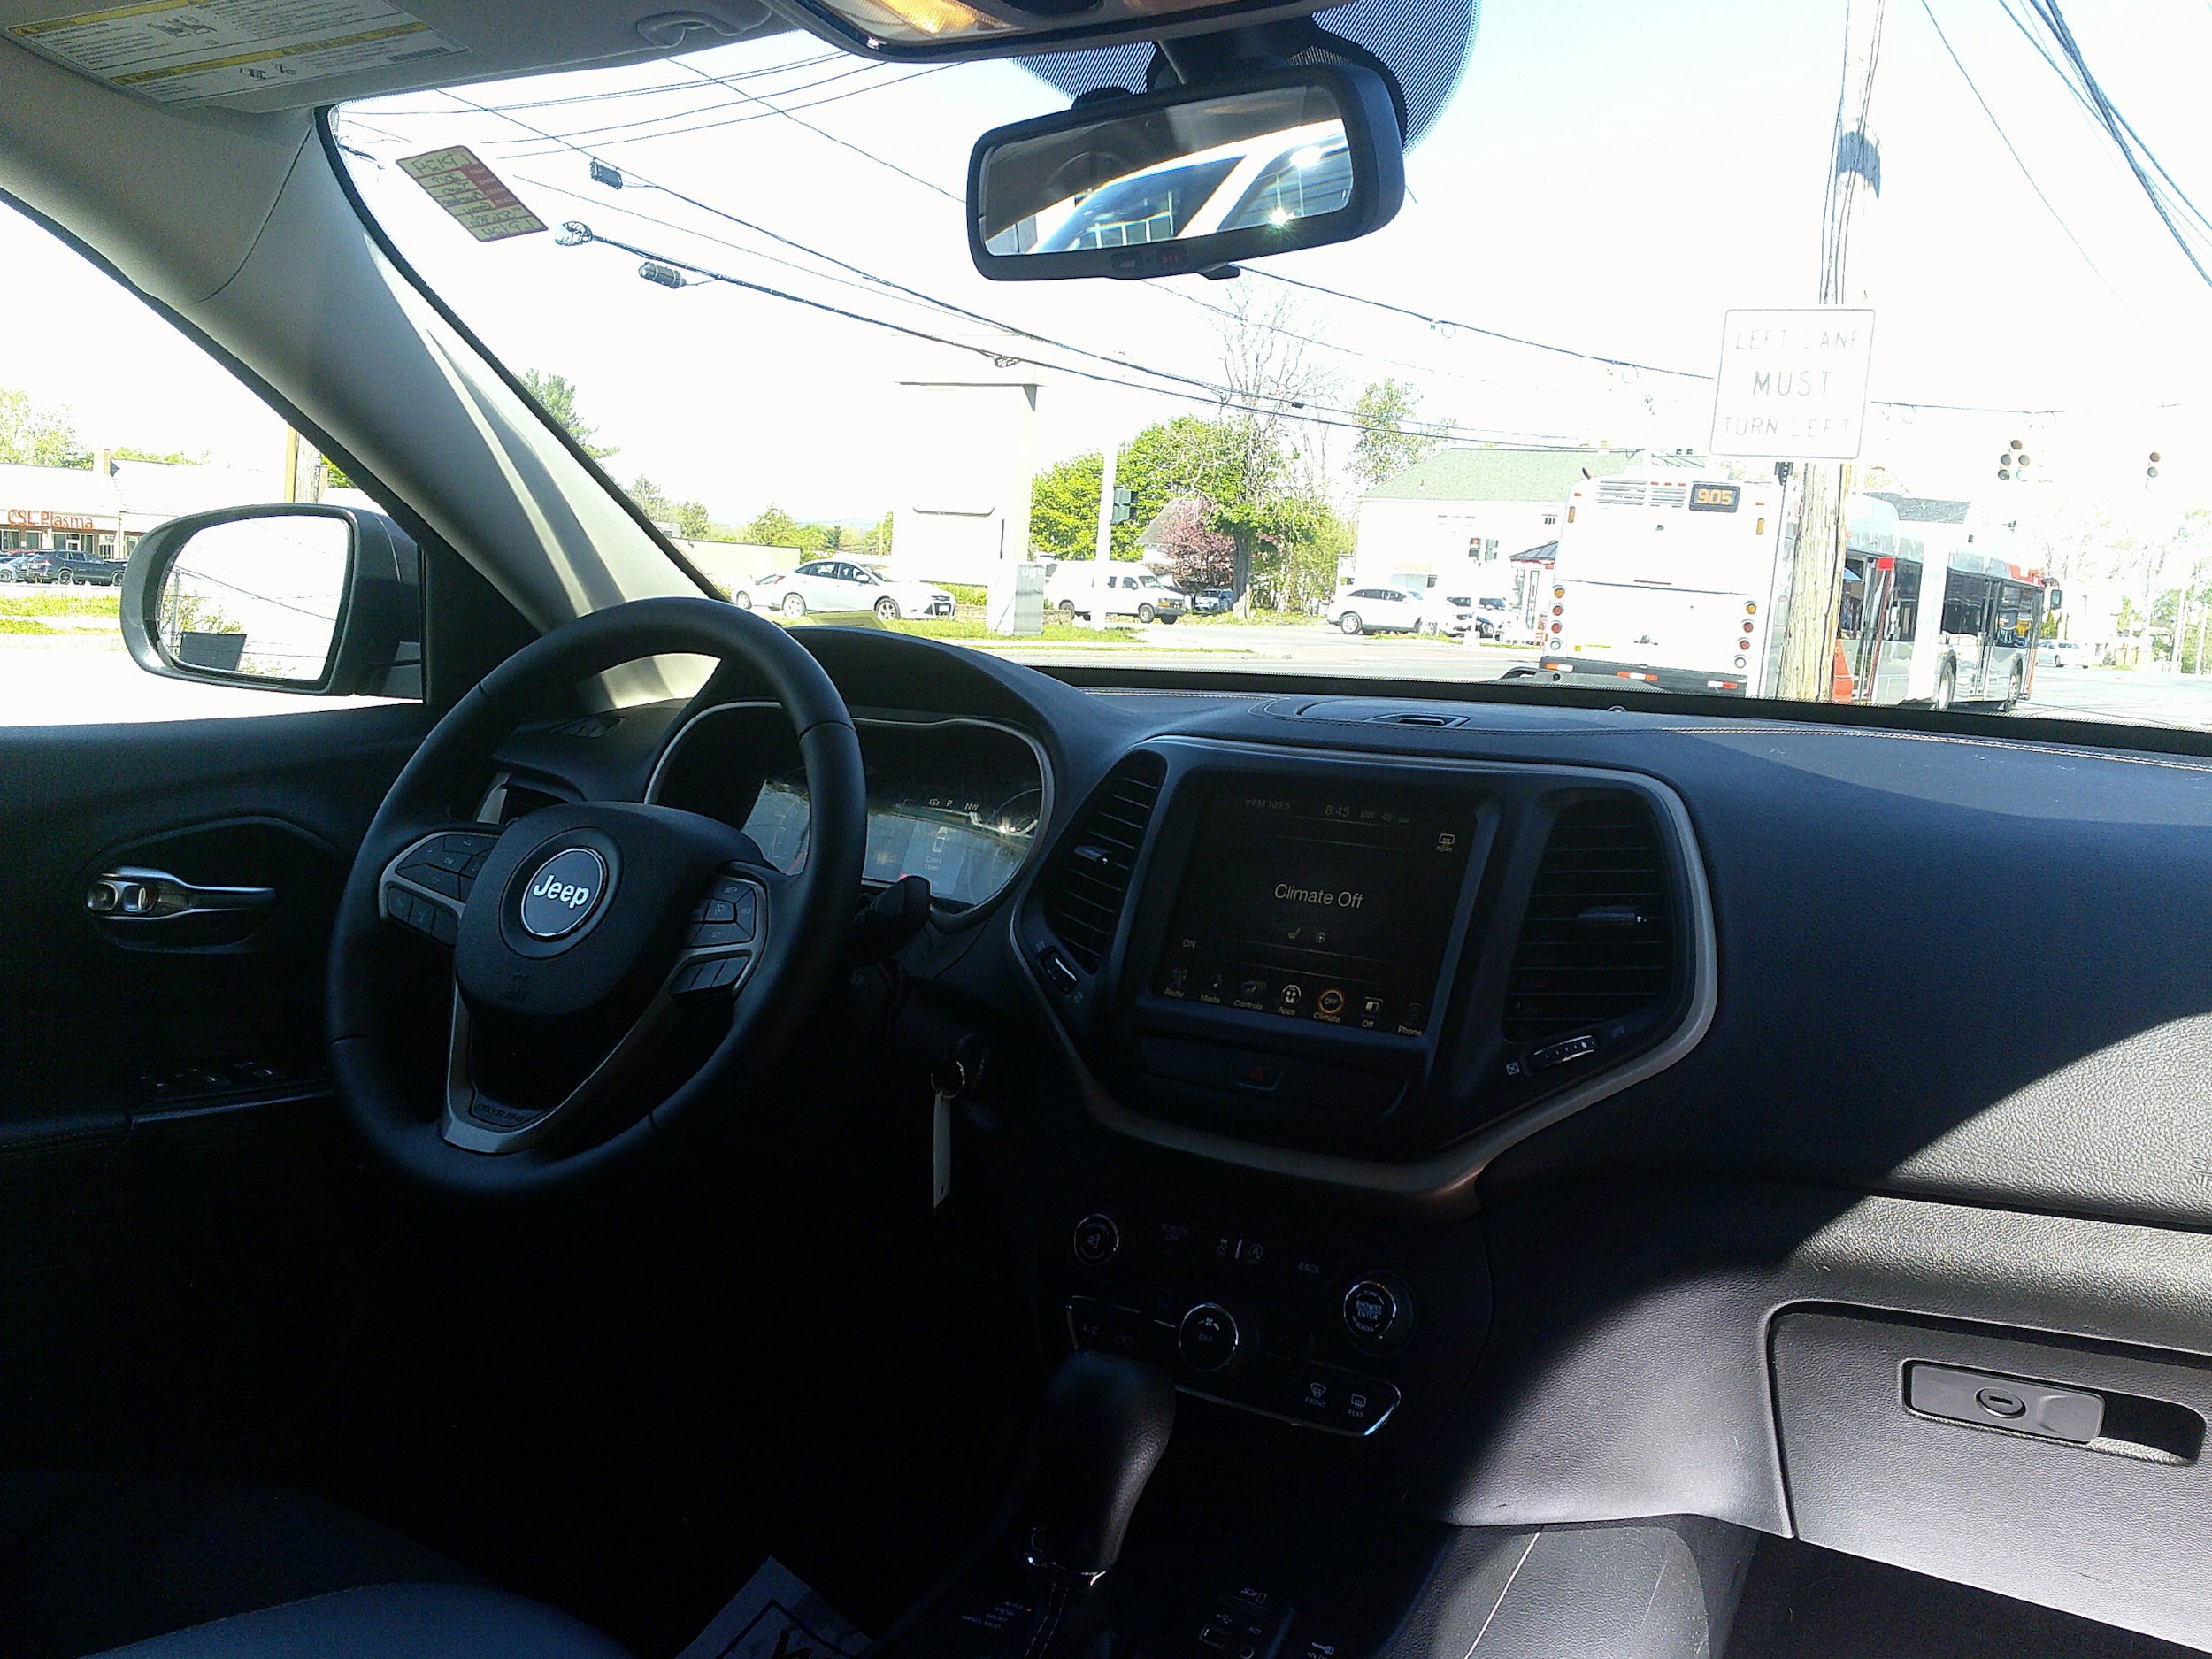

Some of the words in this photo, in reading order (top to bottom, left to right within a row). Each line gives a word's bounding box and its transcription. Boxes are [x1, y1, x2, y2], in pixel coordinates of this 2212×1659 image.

[1736, 329, 1788, 350] LEFT
[1805, 330, 1860, 350] LANE
[1752, 370, 1832, 396] MUST
[1725, 416, 1778, 436] TURN
[1792, 419, 1850, 438] LEFT
[1696, 487, 1732, 506] 905
[8, 509, 39, 526] CSL
[41, 511, 94, 530] Plasma
[964, 803, 979, 811] NW
[1324, 804, 1350, 818] 8:45
[533, 874, 589, 910] Jeep
[1274, 884, 1333, 905] Climate
[1338, 890, 1364, 909] Off
[1181, 938, 1196, 949] ON
[1165, 987, 1185, 999] Radio
[1200, 994, 1221, 1005] Media
[1277, 1005, 1296, 1017] Apps
[1313, 1012, 1341, 1024] Climate
[1362, 1018, 1375, 1029] Off
[1397, 1025, 1423, 1037] Phone
[1298, 1261, 1322, 1275] BACK
[1356, 1300, 1383, 1311] BROWSE
[1358, 1310, 1378, 1320] ENTER
[1198, 1333, 1213, 1344] OFF
